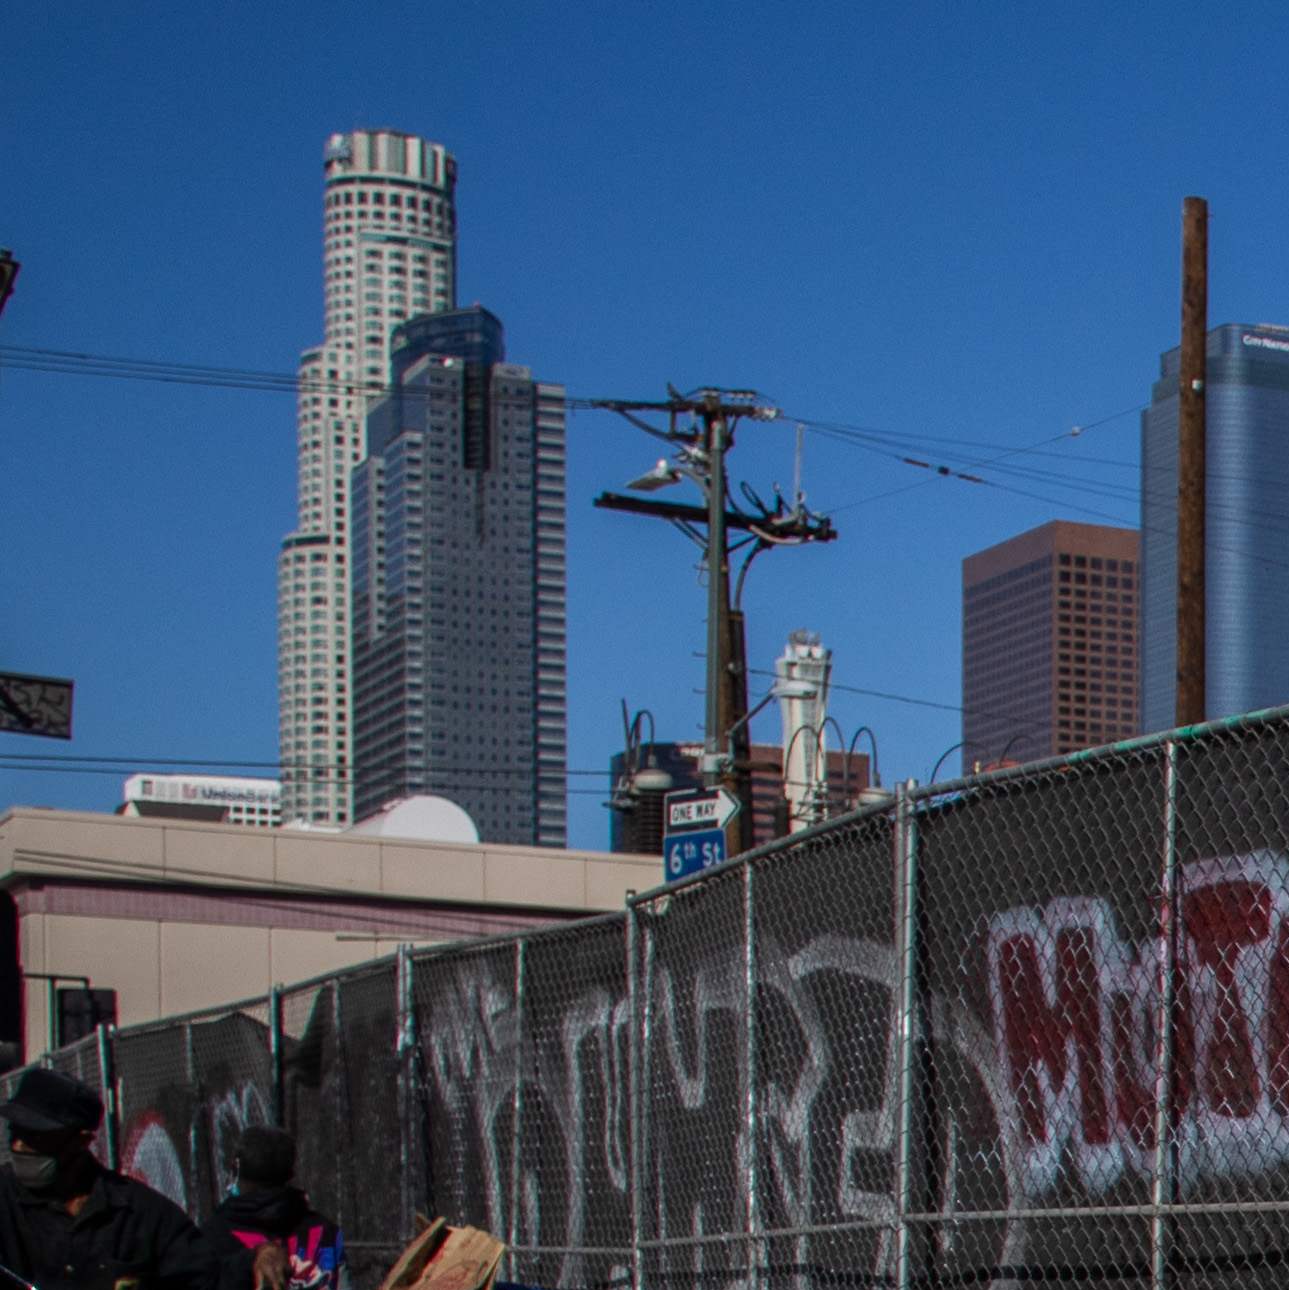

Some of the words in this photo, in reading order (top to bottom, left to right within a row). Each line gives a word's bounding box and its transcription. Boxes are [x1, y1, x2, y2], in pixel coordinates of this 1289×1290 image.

[672, 805, 693, 821] ONE
[695, 803, 716, 817] WAY
[670, 842, 696, 875] 6th
[702, 842, 721, 867] St
